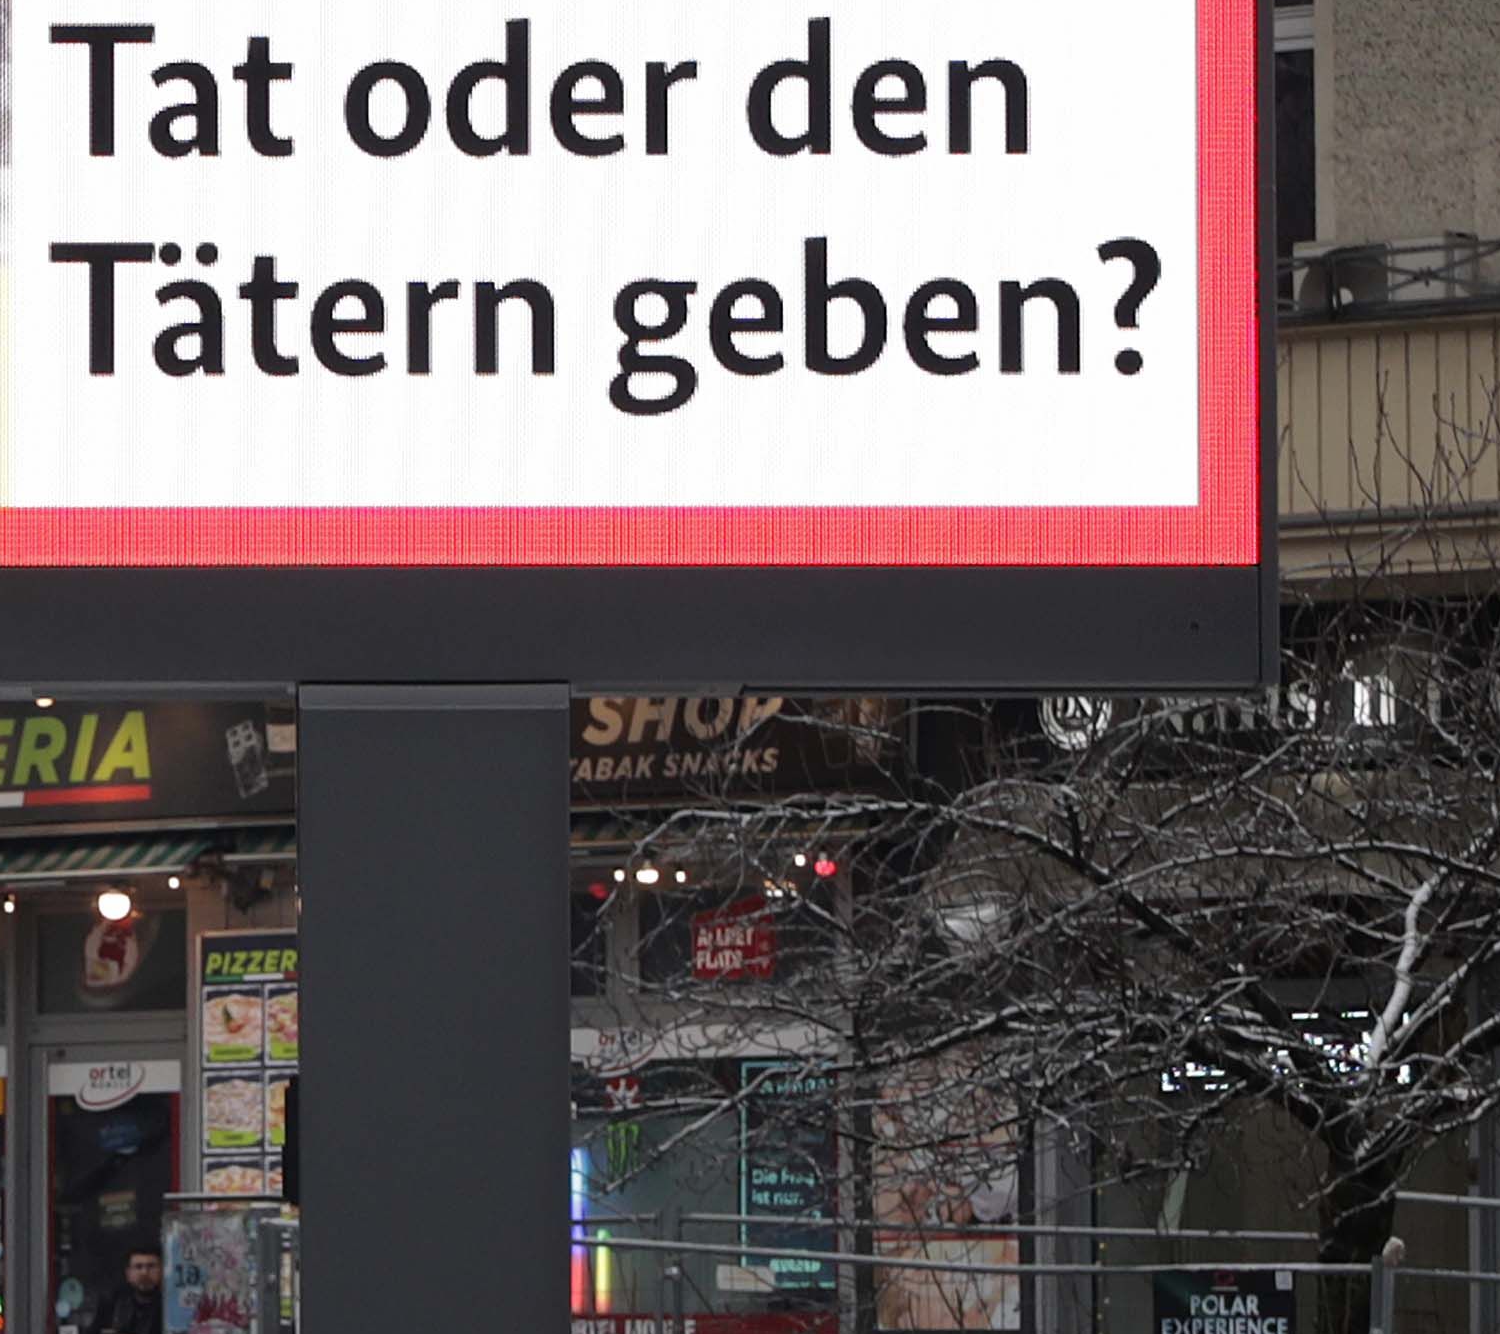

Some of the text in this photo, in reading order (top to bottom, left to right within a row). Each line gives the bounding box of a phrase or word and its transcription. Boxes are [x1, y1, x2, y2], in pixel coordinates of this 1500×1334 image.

[51, 16, 1030, 158] Tat oder den
[51, 236, 1162, 416] Tätern geben?
[1190, 1294, 1260, 1317] POLAR
